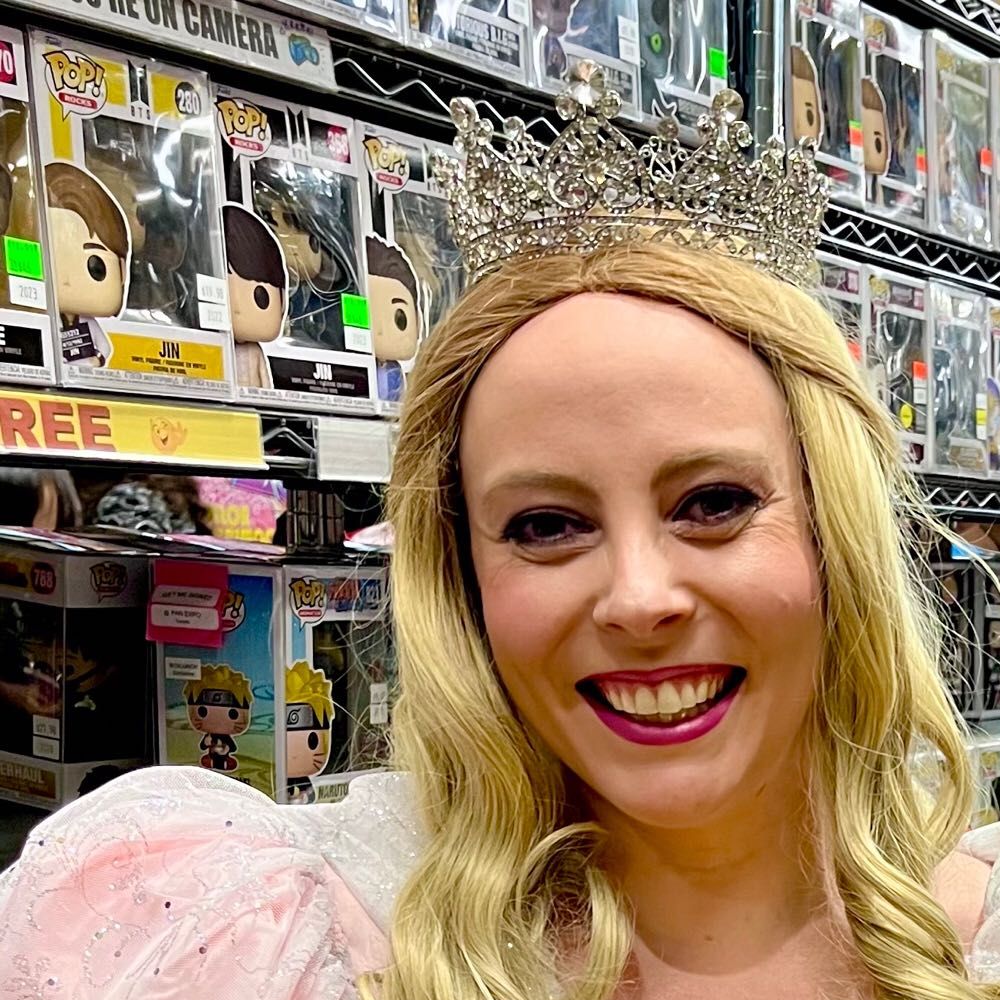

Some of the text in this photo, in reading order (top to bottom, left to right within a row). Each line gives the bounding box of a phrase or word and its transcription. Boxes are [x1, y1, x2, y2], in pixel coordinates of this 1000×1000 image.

[183, 0, 280, 60] CAMERA
[42, 50, 105, 98] POP!
[177, 90, 200, 114] 280
[214, 99, 268, 142] POP!
[159, 341, 180, 359] JIN
[312, 362, 333, 381] JIN
[288, 577, 326, 610] POP!
